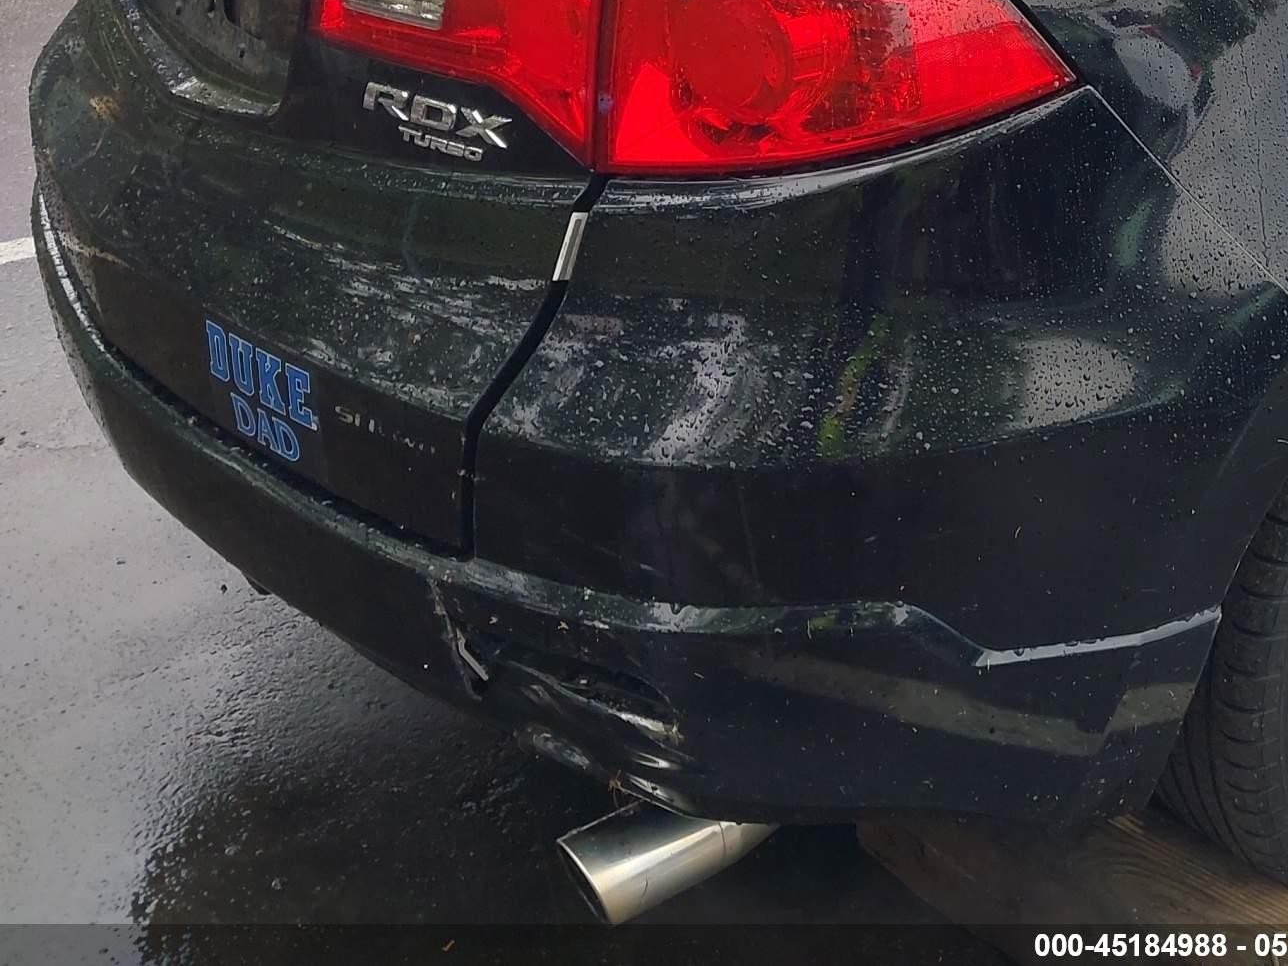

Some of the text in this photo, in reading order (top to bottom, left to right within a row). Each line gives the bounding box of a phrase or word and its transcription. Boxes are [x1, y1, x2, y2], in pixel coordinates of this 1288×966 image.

[363, 82, 513, 149] RDX
[398, 125, 484, 162] TURBO
[206, 320, 312, 429] DUKE
[230, 392, 300, 461] DAD
